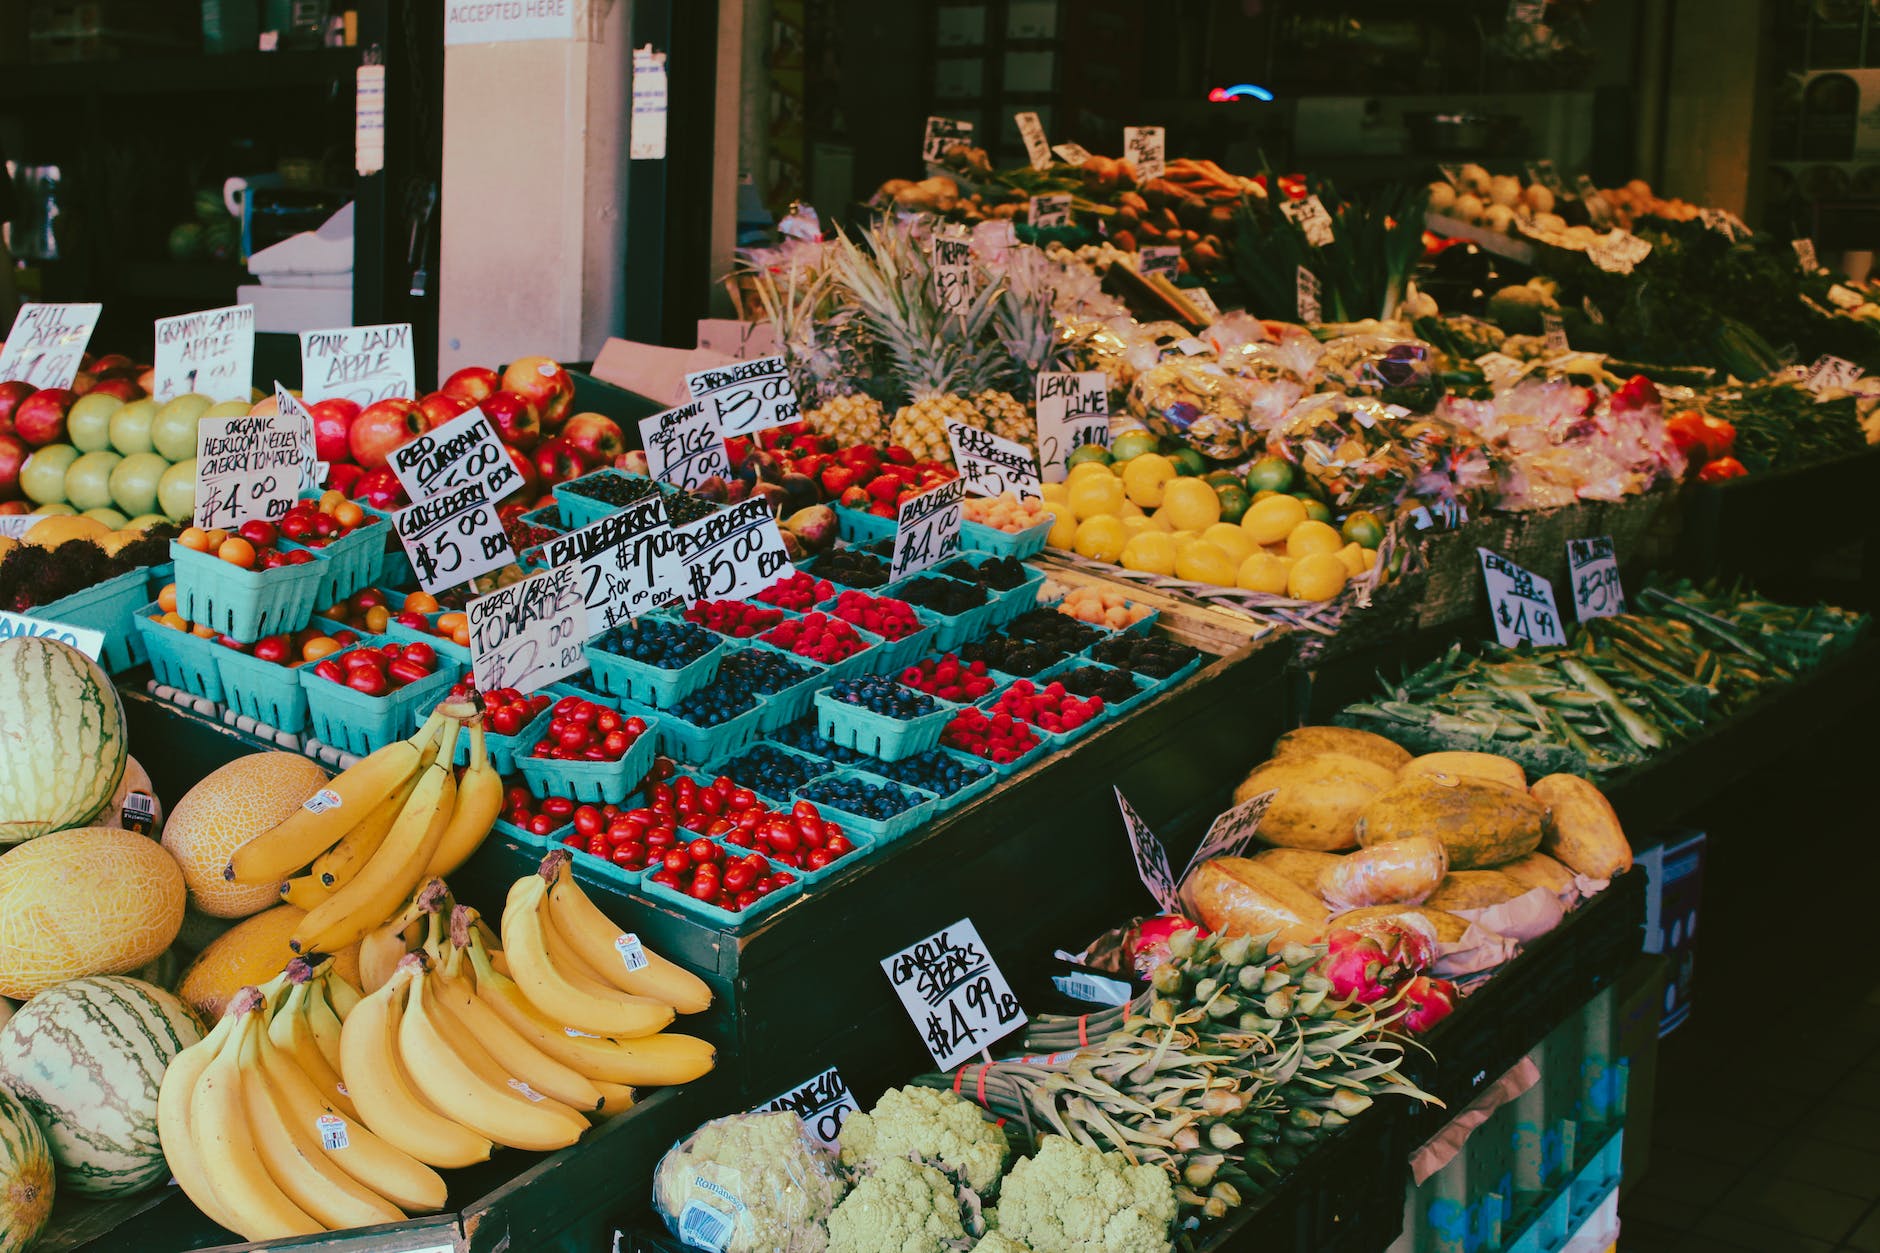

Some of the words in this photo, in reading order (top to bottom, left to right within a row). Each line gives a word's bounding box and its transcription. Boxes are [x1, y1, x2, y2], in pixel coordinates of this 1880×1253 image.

[449, 3, 521, 23] ACCEPTED
[526, 0, 564, 17] HERE
[24, 324, 86, 347] APPLE
[157, 314, 209, 345] GRANNY
[209, 308, 252, 337] SMITH
[180, 332, 233, 362] APPLE
[306, 333, 349, 358] PINK
[361, 326, 408, 351] LADY
[327, 350, 390, 382] APPLE
[1039, 375, 1080, 401] LEMON
[225, 417, 275, 435] ORGANIC
[660, 401, 705, 430] ORGANIC
[203, 433, 259, 456] HEIRLOOM
[261, 430, 298, 451] MEDLEY
[660, 422, 715, 470] FIGS
[949, 423, 994, 446] GOLD
[201, 451, 250, 476] CHERRY
[252, 449, 304, 470] TOMATOES
[395, 436, 436, 473] RED
[416, 419, 490, 485] CURRANT
[487, 463, 519, 492] BOX
[266, 498, 294, 518] BOX
[399, 482, 489, 536] GOOSEBERRY
[900, 477, 967, 526] BLACKBERRY
[480, 532, 511, 560] BOX
[551, 499, 661, 569] BLUEBERRY
[581, 564, 611, 610] 2
[605, 573, 631, 601] for
[651, 587, 677, 606] BOX
[472, 581, 583, 655] TOMATOES
[561, 641, 586, 668] BOX
[892, 932, 957, 985] GARLIC
[917, 943, 985, 1000] SPEARS
[995, 994, 1020, 1025] LB
